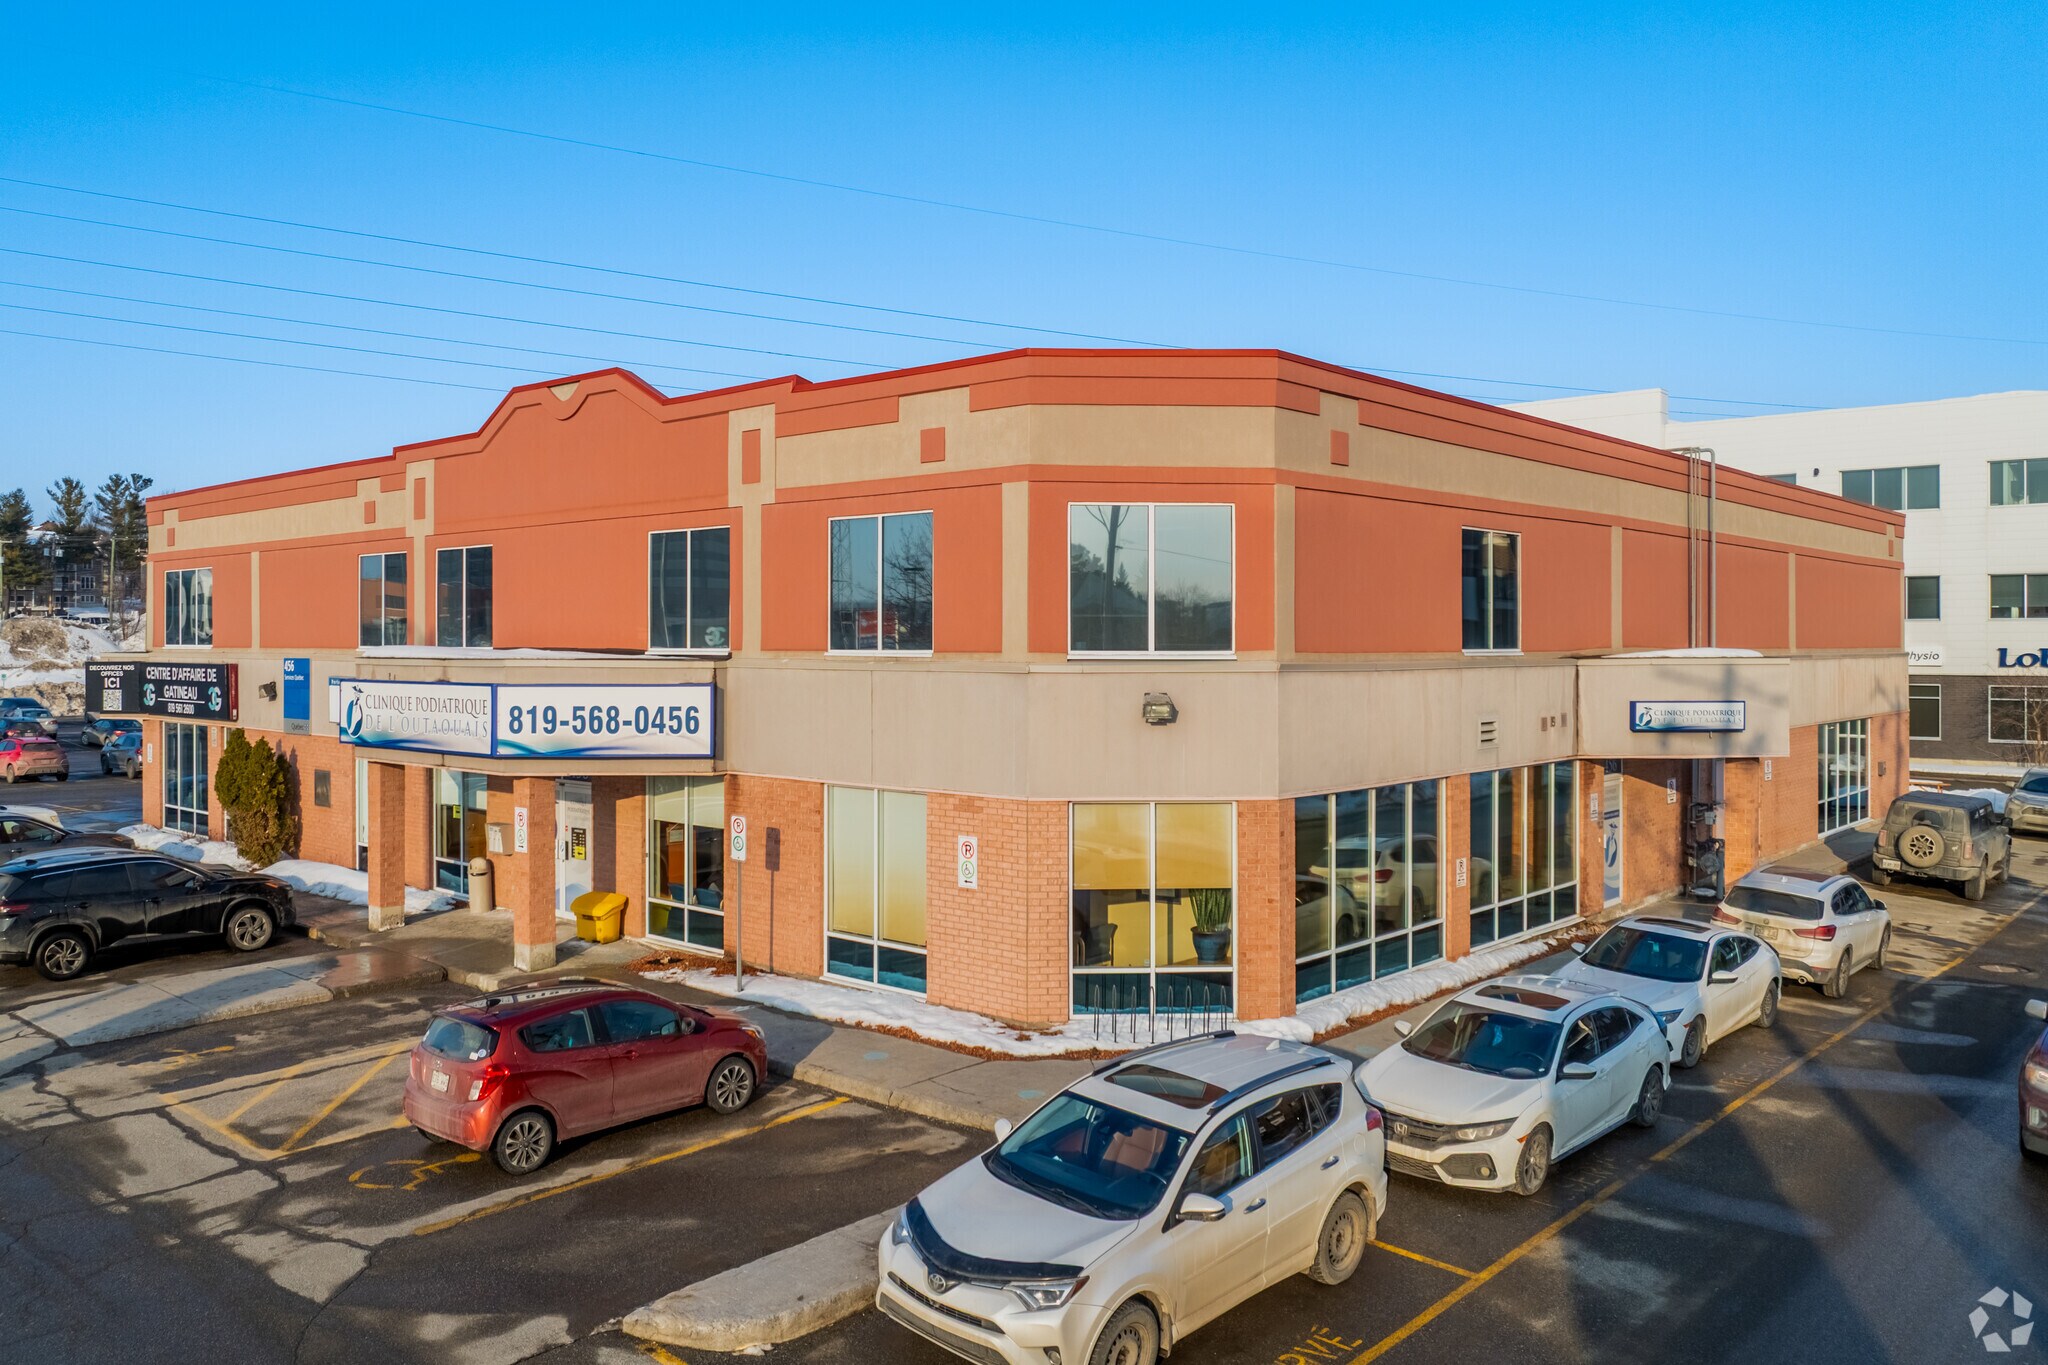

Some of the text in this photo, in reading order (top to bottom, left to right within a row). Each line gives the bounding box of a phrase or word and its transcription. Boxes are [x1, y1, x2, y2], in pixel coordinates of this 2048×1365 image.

[284, 660, 295, 672] 456
[146, 666, 217, 682] CENTRE D'AFFAIRE DE
[104, 677, 120, 688] ICI
[163, 685, 198, 700] GATINEAU
[365, 694, 488, 719] CLINIQUE PODIATRIQUE
[1654, 709, 1742, 718] CLINIQUE PODIATRIQUE
[365, 714, 488, 738] DE L'OUTAOUAIS
[508, 705, 700, 735] 819-568-0456
